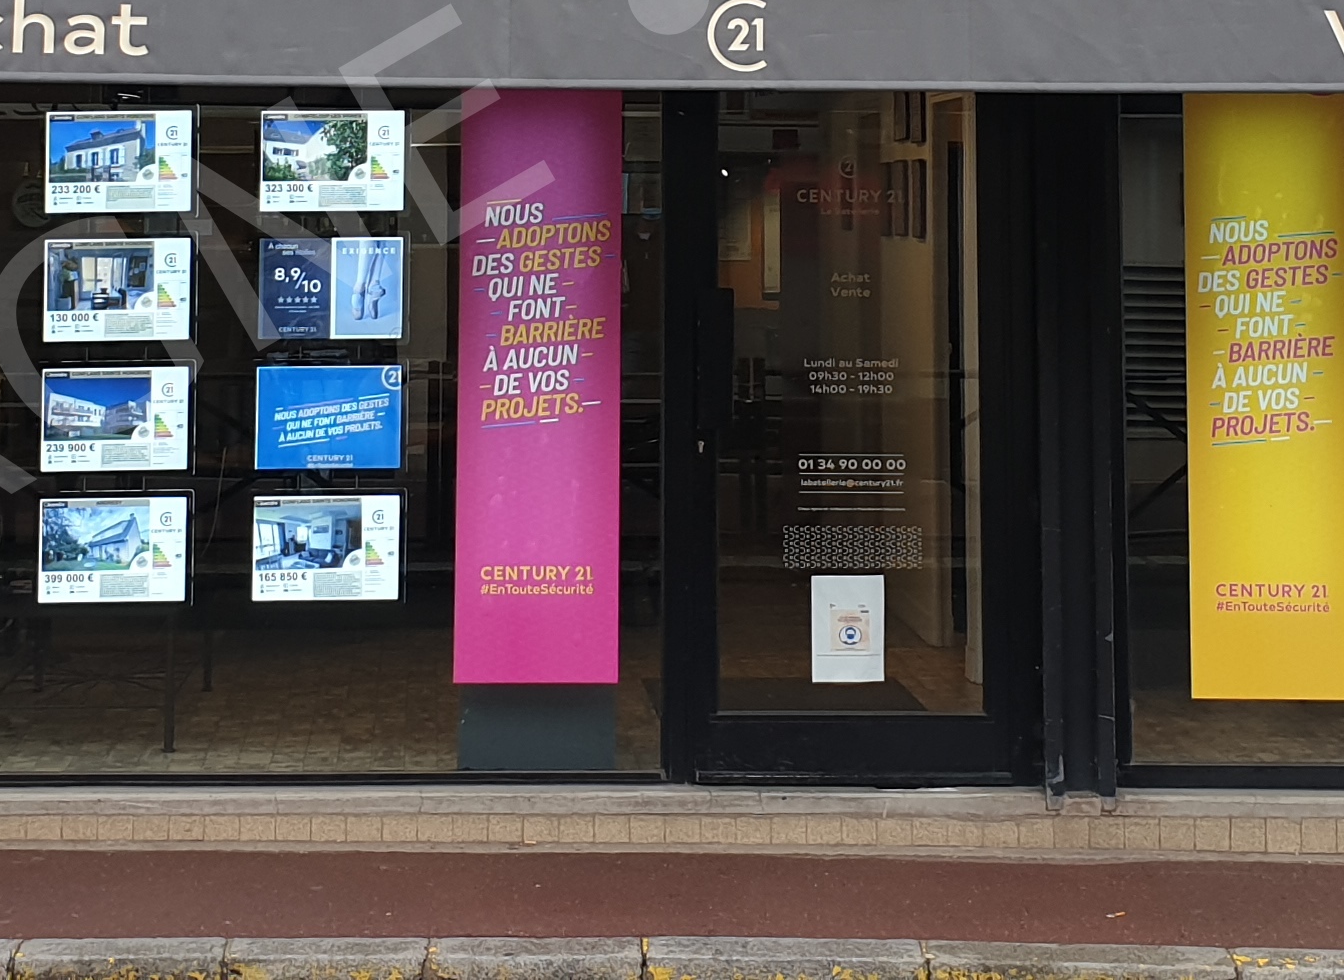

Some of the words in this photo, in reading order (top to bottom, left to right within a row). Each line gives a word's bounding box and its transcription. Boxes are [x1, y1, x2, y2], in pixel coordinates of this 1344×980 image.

[797, 189, 882, 203] CENTURY
[485, 203, 543, 227] NOUS
[497, 220, 611, 249] ADOPTONS
[1209, 220, 1269, 244] NOUS
[472, 253, 514, 276] DES
[520, 246, 602, 272] GESTES
[1222, 238, 1338, 266] ADOPTONS
[488, 276, 524, 301] QUI
[529, 273, 558, 296] NE
[831, 272, 871, 283] Achat
[1198, 270, 1240, 293] DES
[1246, 264, 1329, 289] GESTES
[831, 287, 871, 298] Vente
[508, 297, 566, 321] FONT
[1215, 293, 1250, 319] QUI
[1256, 291, 1286, 313] NE
[500, 315, 606, 346] BARRIÈRE
[1235, 315, 1294, 339] FONT
[483, 345, 498, 372] À
[503, 344, 578, 370] AUCUN
[1228, 333, 1335, 363] BARRIÈRE
[804, 358, 836, 368] Lundi
[838, 359, 853, 368] au
[856, 358, 899, 368] Samedi
[494, 373, 523, 396] DE
[528, 370, 570, 393] VOS
[809, 371, 847, 381] 09h30
[858, 371, 895, 381] 12h00
[1212, 363, 1226, 389] À
[1232, 362, 1308, 388] AUCUN
[810, 384, 847, 394] 14h00
[857, 384, 893, 394] 19h30
[1223, 390, 1252, 413] DE
[1258, 388, 1300, 411] VOS
[274, 410, 297, 421] NOUS
[297, 404, 340, 418] ADOPTONS
[341, 402, 357, 412] DES
[481, 393, 584, 421] PROJETS.
[286, 421, 300, 431] QUI
[301, 418, 313, 428] NE
[314, 415, 335, 426] FONT
[286, 431, 314, 441] AUCUN
[316, 428, 326, 437] DE
[327, 425, 344, 436] VOS
[1212, 412, 1315, 438] PROJETS.
[798, 459, 814, 470] 01
[817, 459, 835, 470] 34
[838, 459, 858, 470] 90
[862, 459, 882, 470] 00
[886, 459, 906, 470] 00
[480, 565, 570, 581] CENTURY
[480, 583, 594, 595] #EnTouteSécurité
[1216, 583, 1305, 598] CENTURY
[1217, 601, 1330, 613] #EnTouteSécurité
